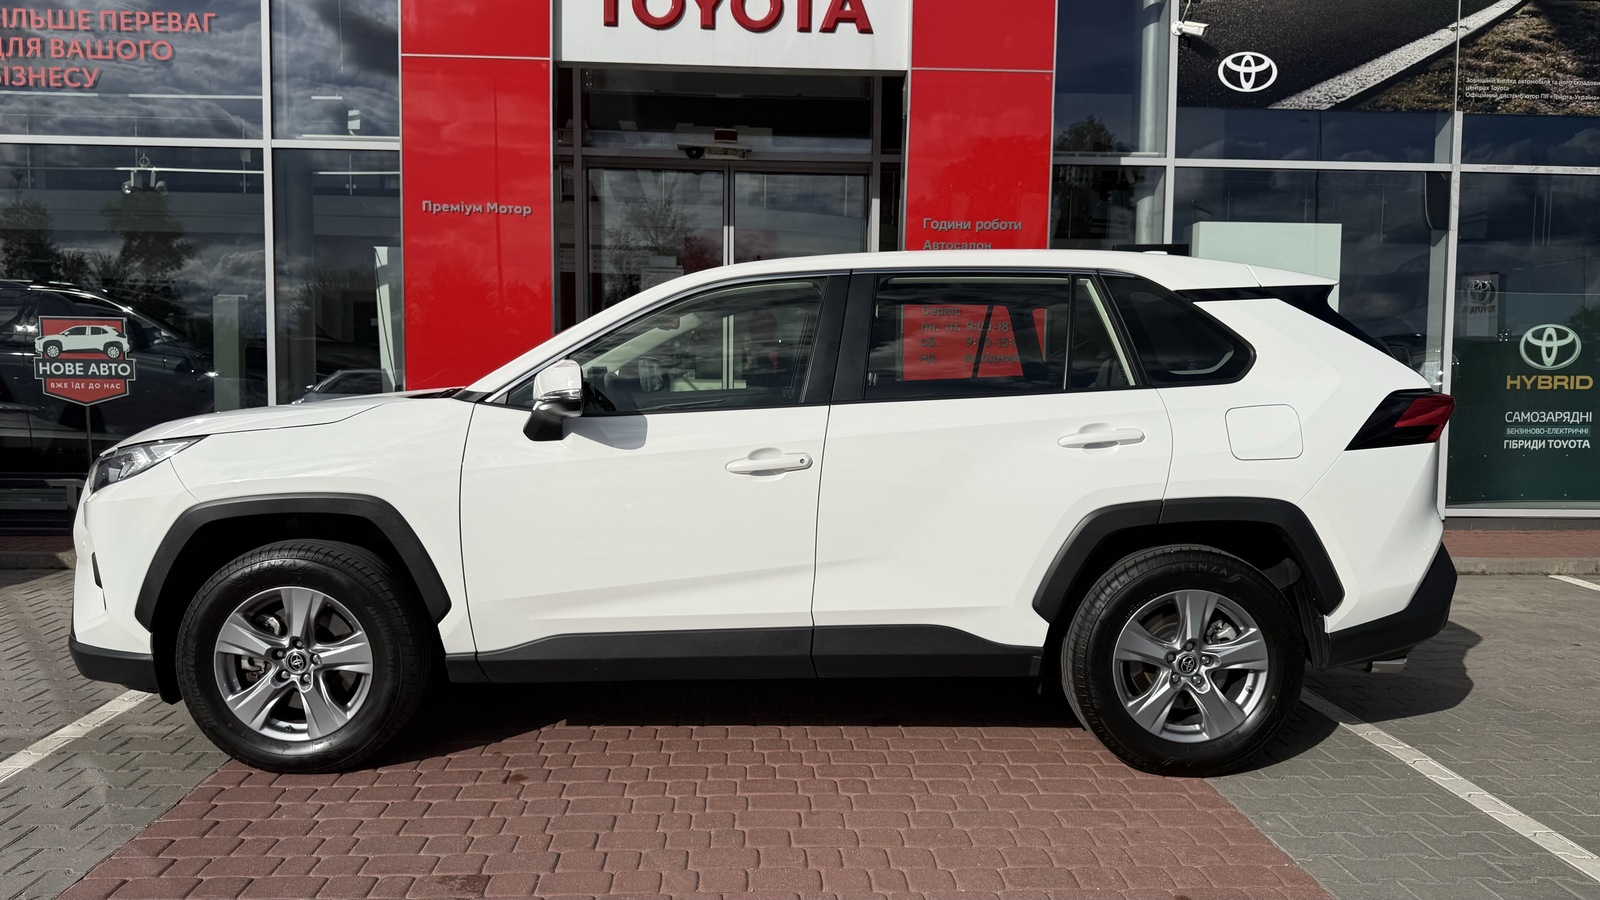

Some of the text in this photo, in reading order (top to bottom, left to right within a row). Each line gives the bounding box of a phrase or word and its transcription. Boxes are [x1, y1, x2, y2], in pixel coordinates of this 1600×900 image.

[2, 8, 216, 33] ІЛЬШЕ ПЕРЕВАГ
[0, 37, 173, 61] ЛЯ ВАШОГО
[0, 65, 99, 88] ІЗНЕСУ
[1491, 85, 1510, 93] Toyota
[422, 200, 532, 217] Преміум Мотор
[923, 218, 1022, 233] Години роботи
[923, 239, 992, 250] Автосалон
[921, 305, 961, 317] Сервіс
[964, 352, 1020, 365] виідний
[39, 362, 131, 376] НОВЕ АВТО
[71, 381, 86, 390] ЇДЕ
[88, 382, 101, 390] ДО
[1506, 375, 1594, 390] HYBRID
[1504, 411, 1593, 424] САМОЗАРЯДНІ
[1503, 439, 1591, 450] ГІБРИДИ TOYOTA
[1170, 562, 1228, 576] ALENZA
